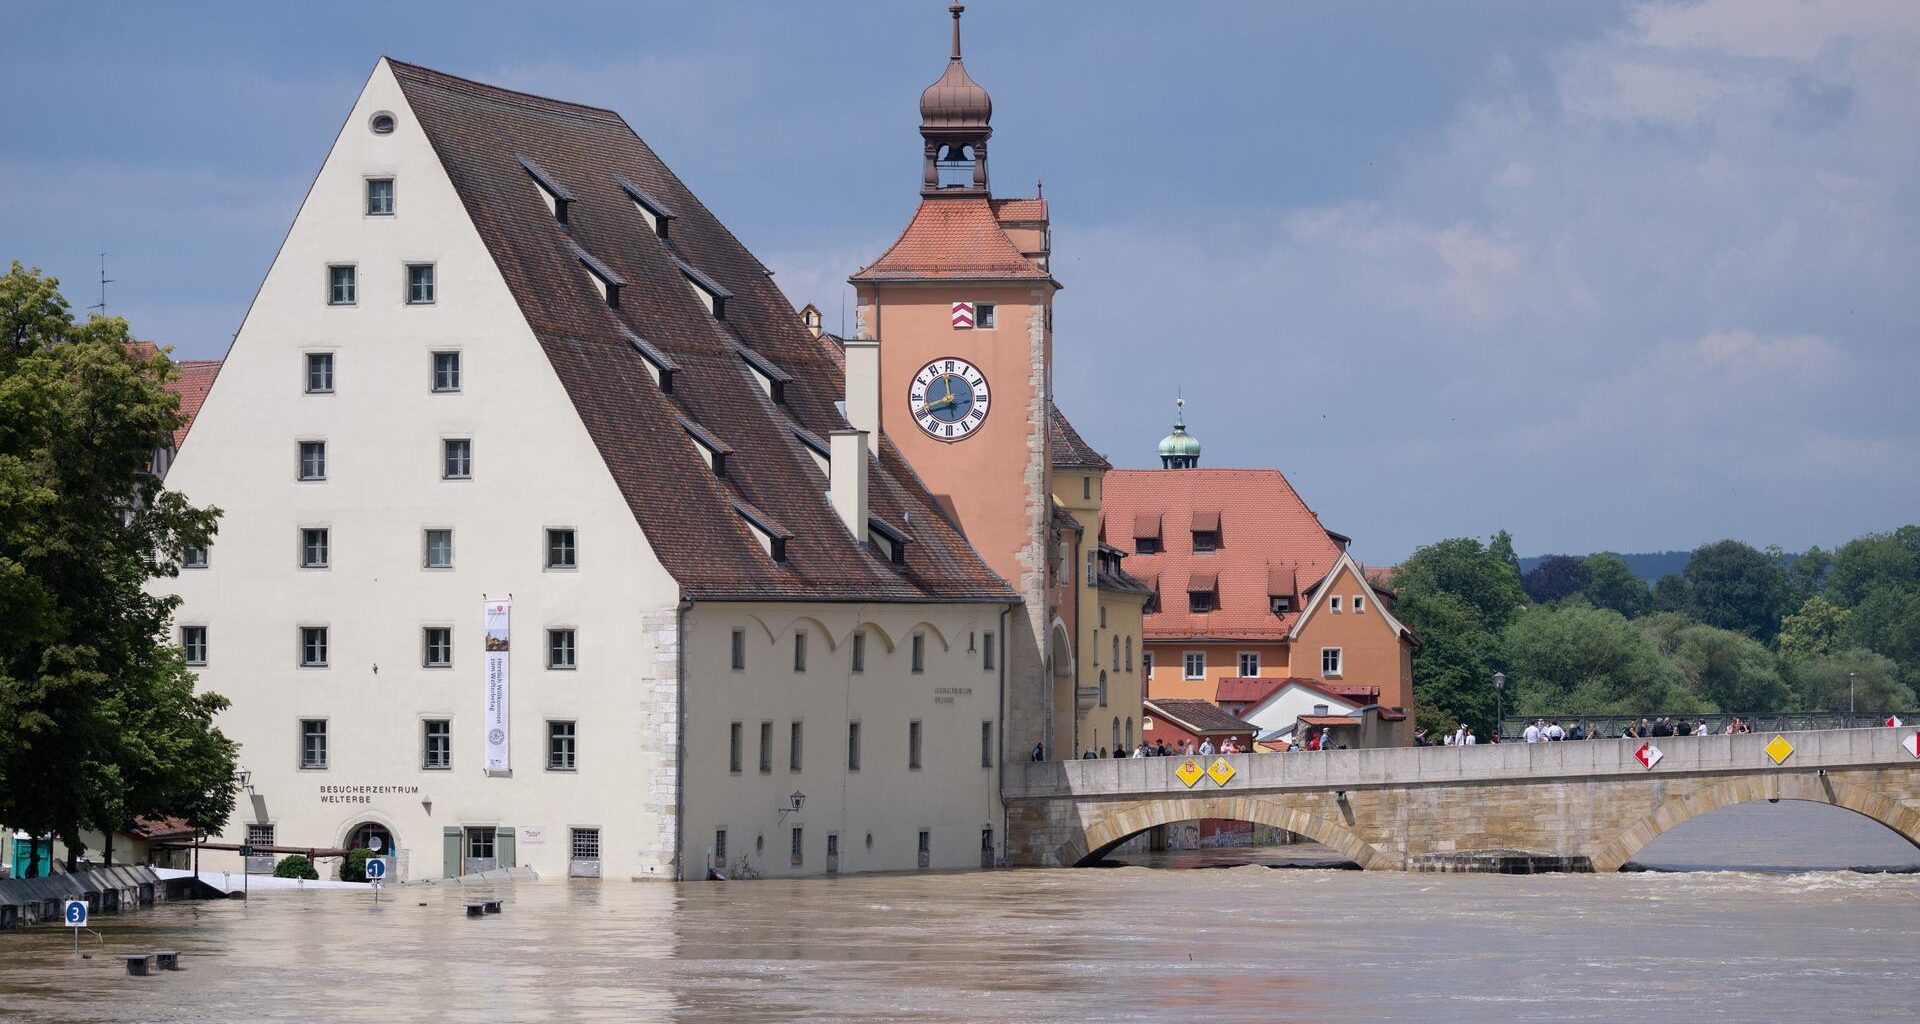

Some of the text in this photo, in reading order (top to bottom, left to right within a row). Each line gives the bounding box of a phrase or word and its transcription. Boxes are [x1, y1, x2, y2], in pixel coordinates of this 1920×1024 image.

[972, 378, 982, 387] II
[320, 786, 418, 794] BESUCHERZENTRUM
[320, 796, 370, 804] WELTERBE
[372, 863, 378, 875] 1
[72, 907, 80, 922] 3
